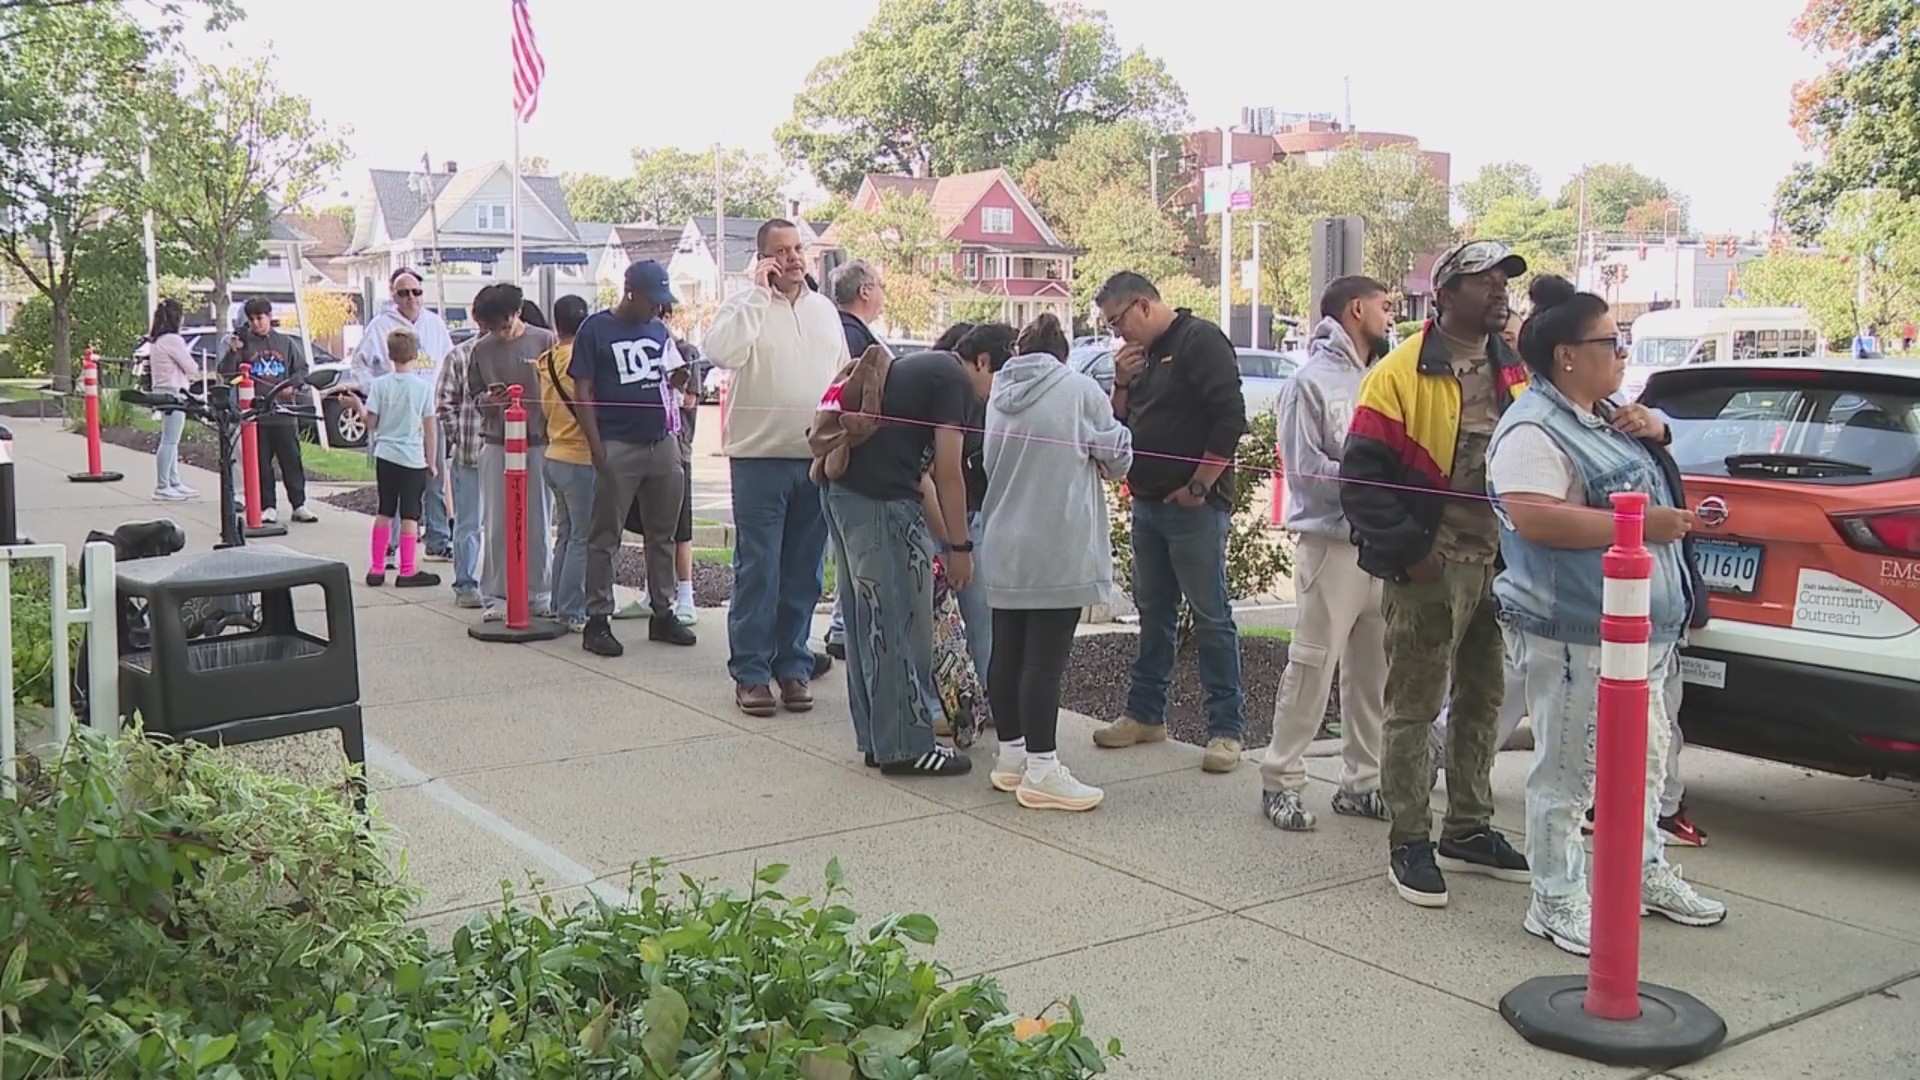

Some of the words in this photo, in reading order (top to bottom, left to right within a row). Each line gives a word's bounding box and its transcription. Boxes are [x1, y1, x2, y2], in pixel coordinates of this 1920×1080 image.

[1880, 559, 1920, 581] EMS
[1799, 590, 1884, 614] Community
[1796, 607, 1861, 626] Outreach
